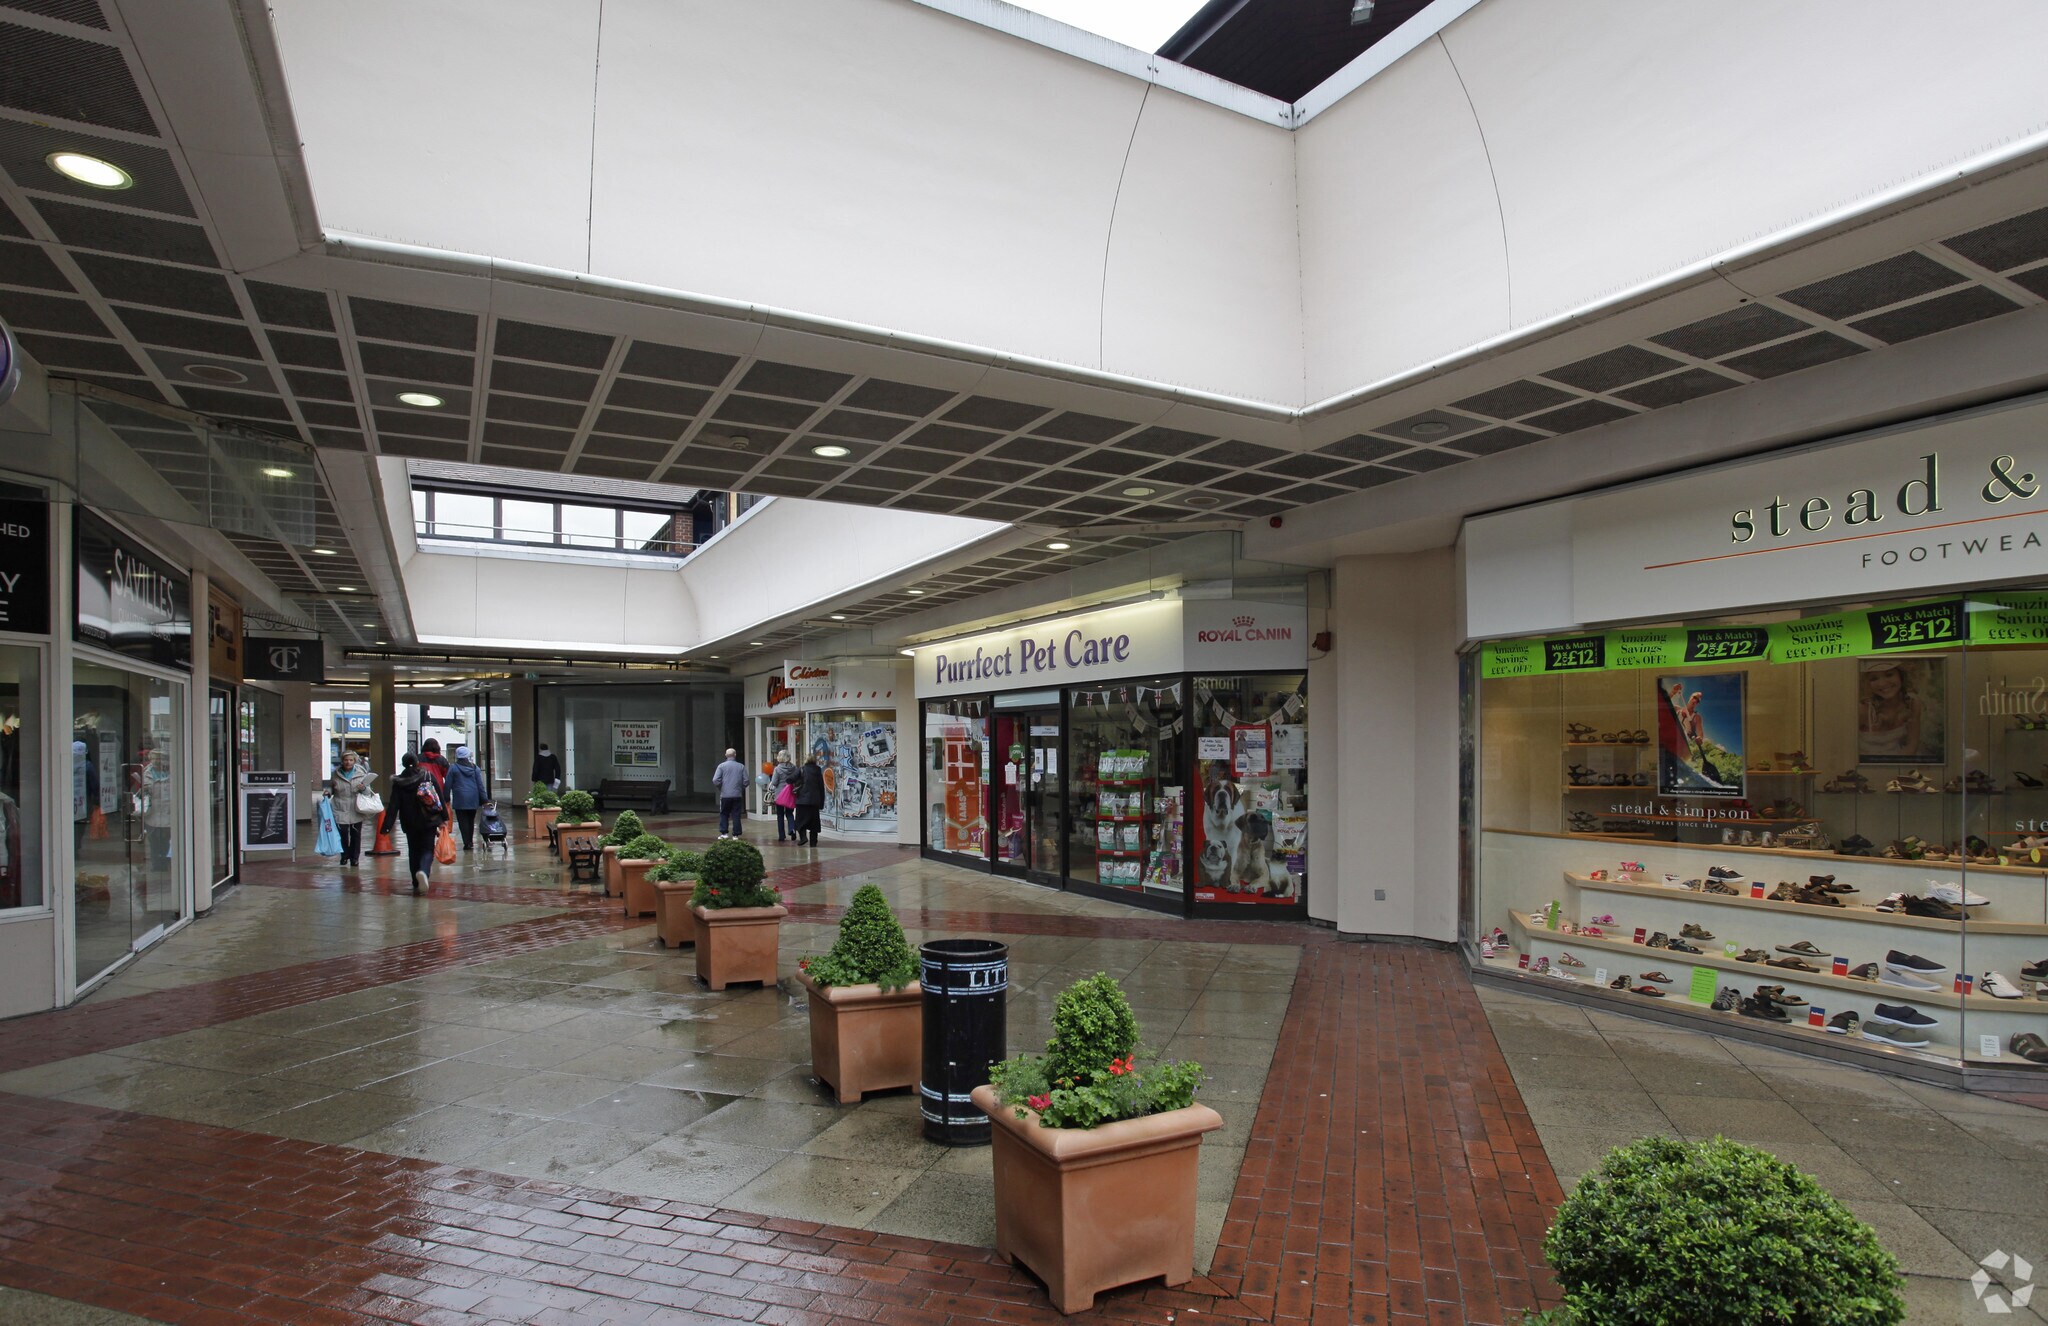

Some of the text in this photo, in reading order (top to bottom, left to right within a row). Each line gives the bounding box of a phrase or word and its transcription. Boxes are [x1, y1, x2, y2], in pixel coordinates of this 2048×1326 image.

[1731, 452, 2041, 544] stead &
[1862, 531, 2041, 568] FOOTWEA
[115, 548, 174, 620] SAVILLES
[1880, 613, 1900, 624] Mix
[1903, 611, 1913, 621] &
[1915, 606, 1950, 619] Match
[1785, 618, 1844, 634] Amazing
[1883, 624, 1899, 644] 2
[1907, 617, 1952, 641] £12
[1198, 628, 1291, 642] ROYAL CANIN
[1619, 632, 1667, 643] Amazing
[1697, 631, 1753, 641] Mix & Match
[1791, 631, 1843, 646] Savings
[1494, 643, 1529, 655] Amazing
[1572, 640, 1594, 649] Match
[1621, 643, 1662, 654] Savings
[1715, 640, 1753, 657] £12
[1785, 643, 1850, 659] £££'s OFF!
[936, 629, 1130, 685] Purrfect Pet Care
[1495, 654, 1528, 664] Savings
[1568, 648, 1594, 665] £12
[1643, 655, 1667, 665] OFF!
[1513, 664, 1533, 673] OFF!
[349, 717, 370, 728] GRE
[636, 730, 650, 738] LET
[864, 728, 882, 738] DAD
[959, 795, 967, 821] IAMS
[1610, 801, 1750, 822] stead & simpson
